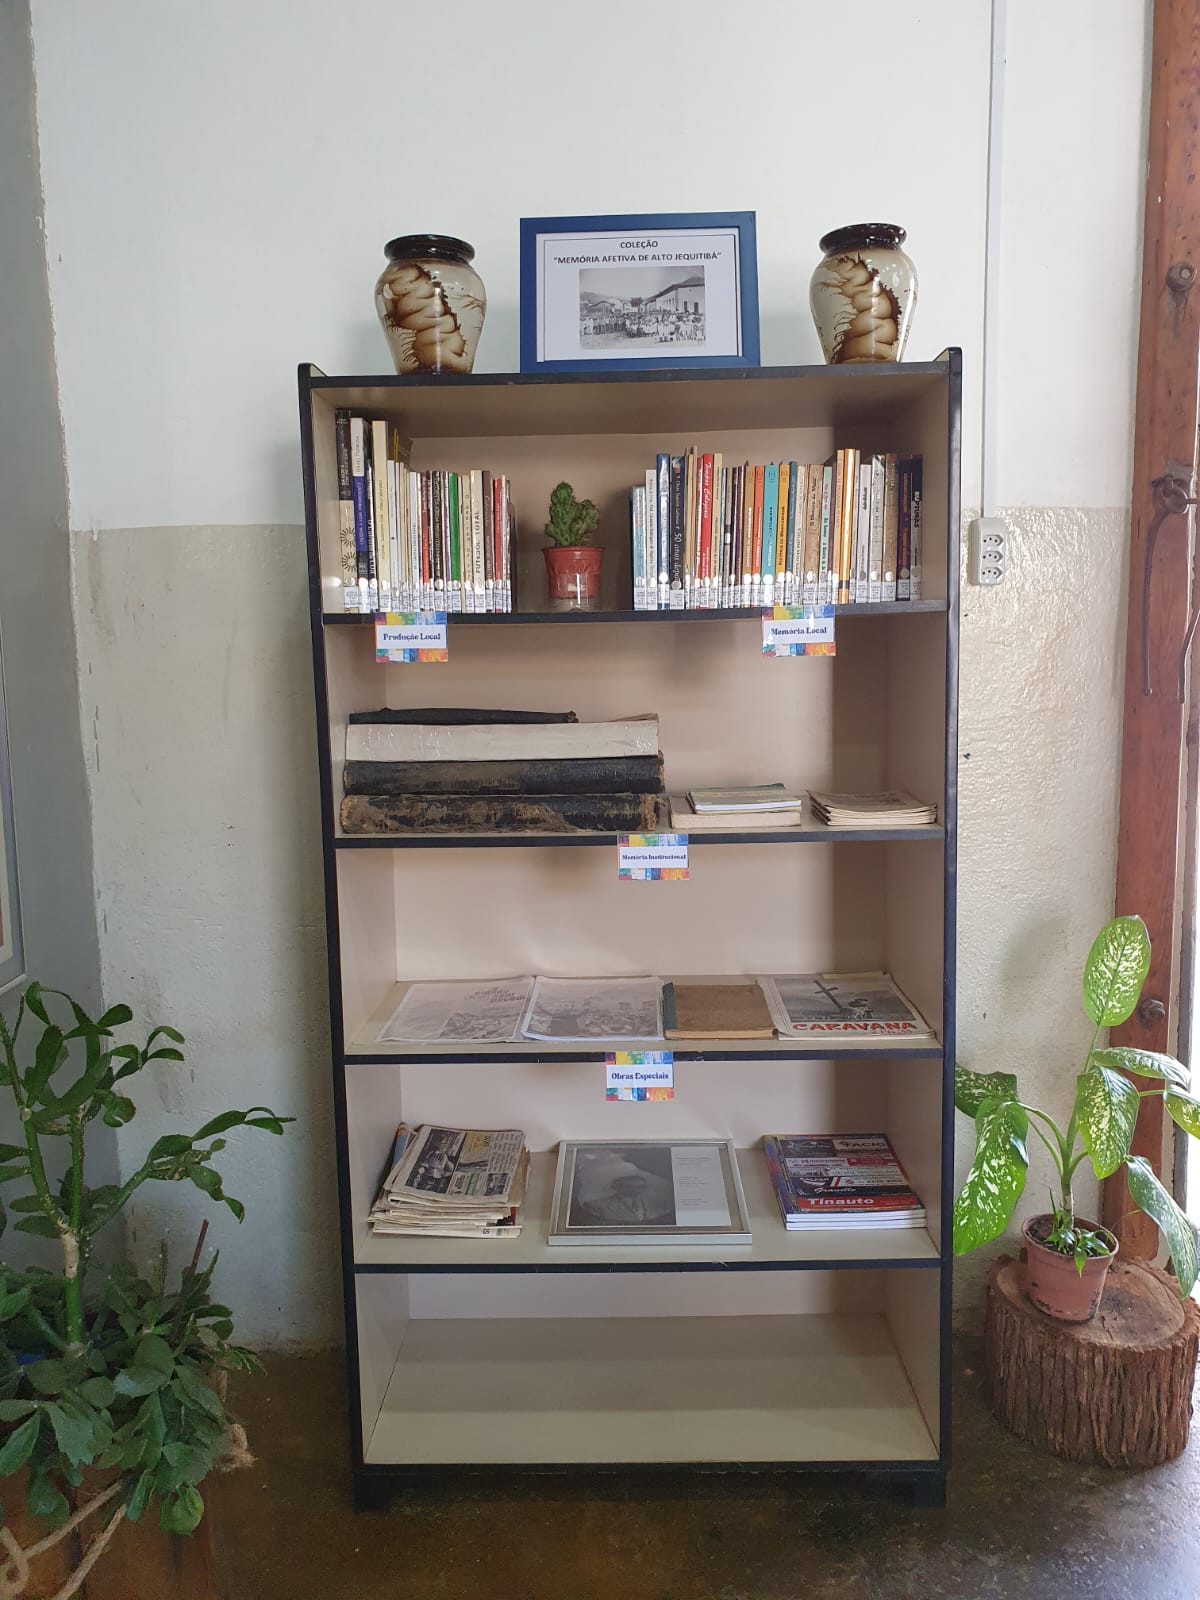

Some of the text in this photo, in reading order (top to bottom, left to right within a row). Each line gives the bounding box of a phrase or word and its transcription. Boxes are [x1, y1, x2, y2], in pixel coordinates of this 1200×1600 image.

[620, 240, 659, 249] COLEÇÃO
[601, 254, 636, 263] AFETIVA
[638, 254, 649, 262] DE
[651, 253, 673, 261] ALTO
[674, 532, 682, 543] 50
[771, 626, 827, 636] Memória Local
[383, 633, 419, 642] Produção
[792, 1022, 918, 1031] CARAVANA
[611, 1072, 669, 1081] Obras Especiais
